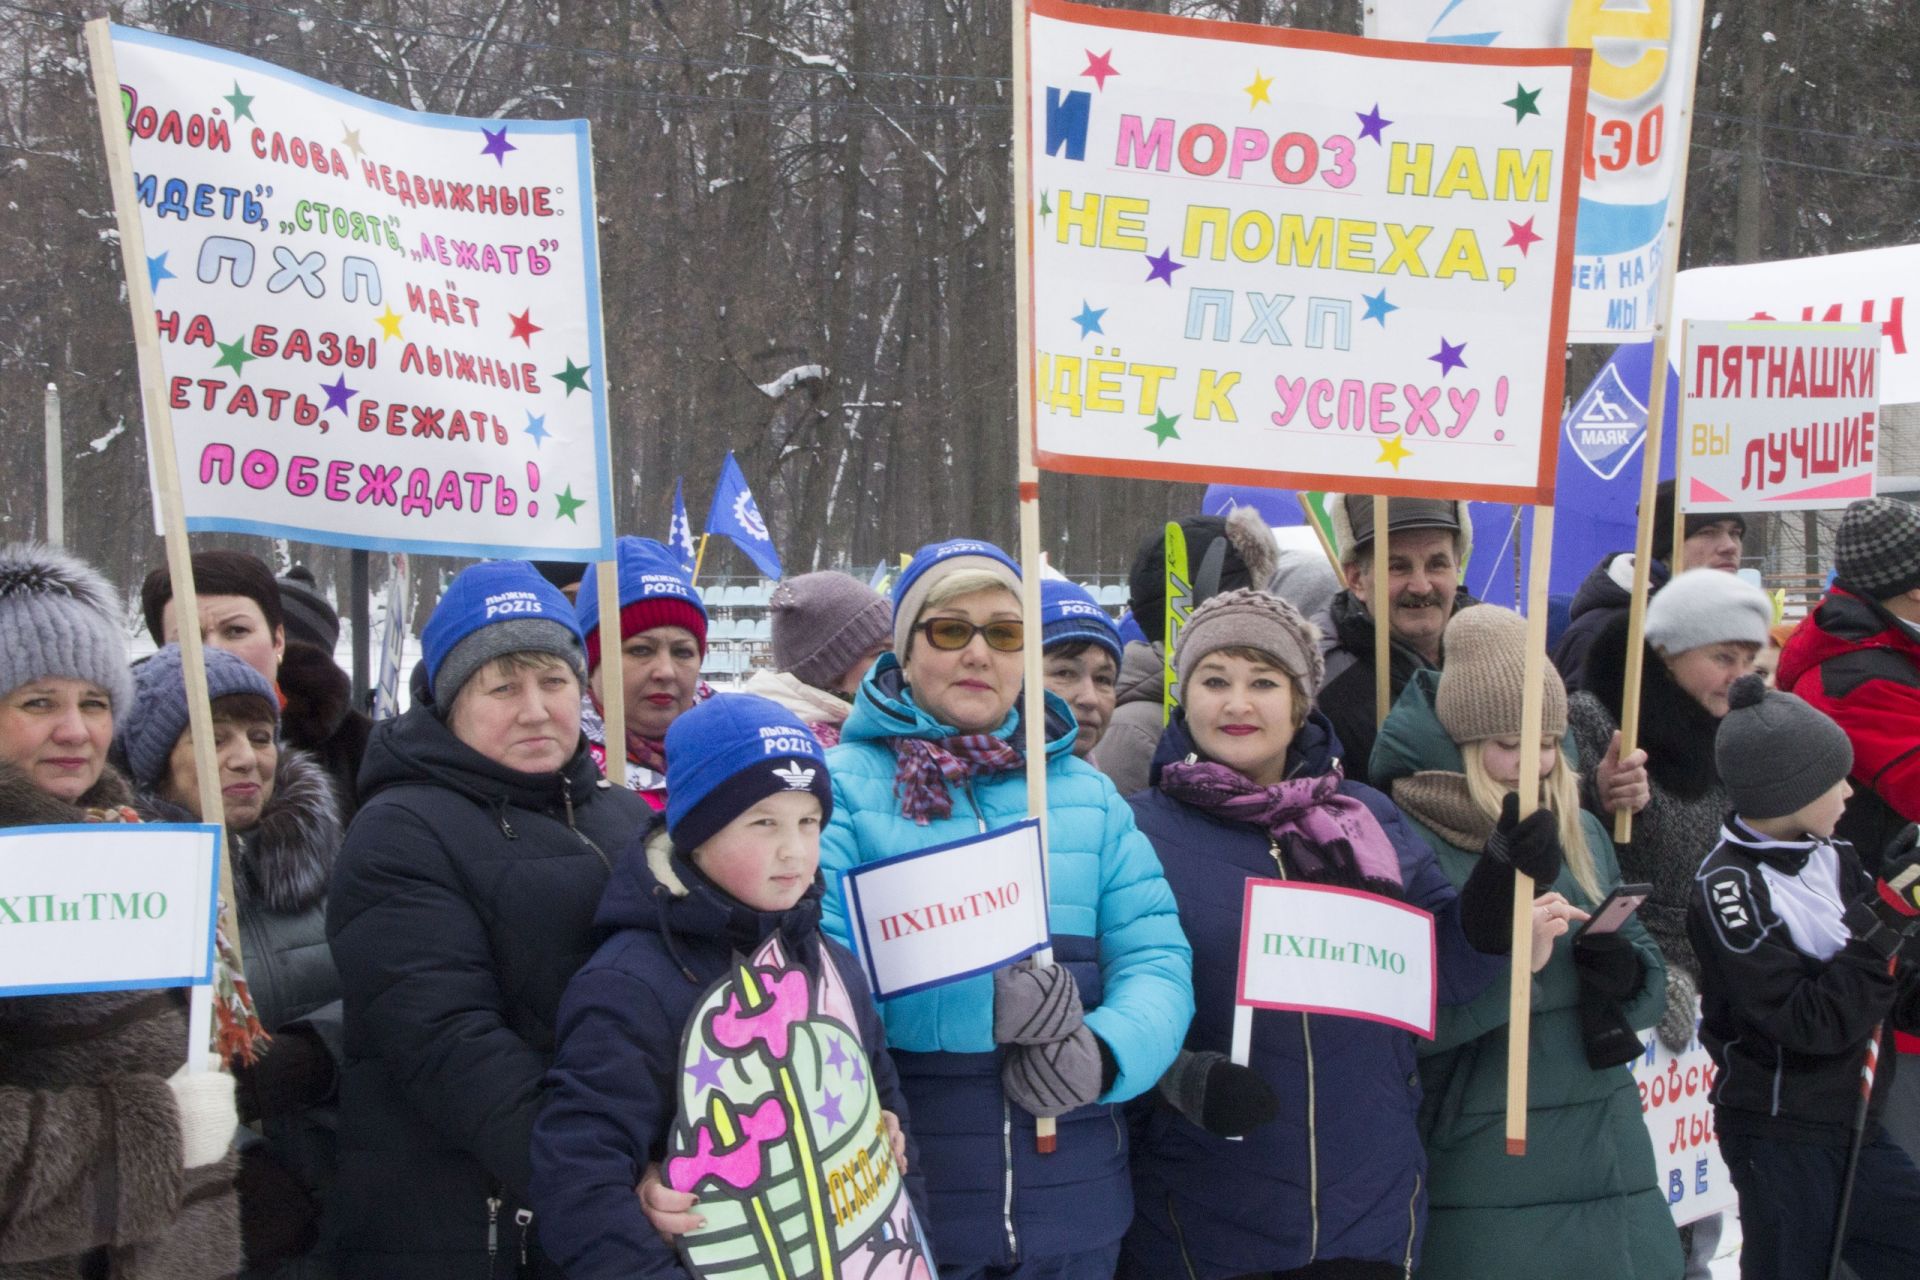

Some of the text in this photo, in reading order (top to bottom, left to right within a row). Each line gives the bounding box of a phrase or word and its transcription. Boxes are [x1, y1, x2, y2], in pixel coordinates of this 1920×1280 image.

[251, 127, 349, 180] СЛОВА
[361, 158, 565, 217] НЕДВИЖНЫЕ:
[1045, 86, 1553, 202] И МОРОЗ НАМ
[1056, 189, 1517, 291] НЕ ПОМЕХА,
[197, 235, 480, 327] ПХП ИДЁТ
[155, 310, 541, 394] НА БАЗЫ ЛЫЖНЫЕ
[1184, 287, 1352, 351] ПХП
[169, 376, 509, 446] ЕТАТЬ, БЕЖАТЬ
[1193, 368, 1242, 423] К
[1271, 375, 1510, 442] УСПЕХУ!
[1581, 430, 1630, 445] МАЯК
[199, 442, 541, 518] ПОБЕЖДАТЬ!
[1691, 412, 1875, 491] ВЫ ЛУЧШИЕ
[486, 600, 543, 619] POZIS
[644, 583, 689, 596] POZIS
[764, 737, 814, 755] POZIS
[0, 891, 168, 925] ХПиТМО
[878, 882, 1020, 942] ПХПиТМО
[1262, 933, 1406, 975] ПХПиТМО
